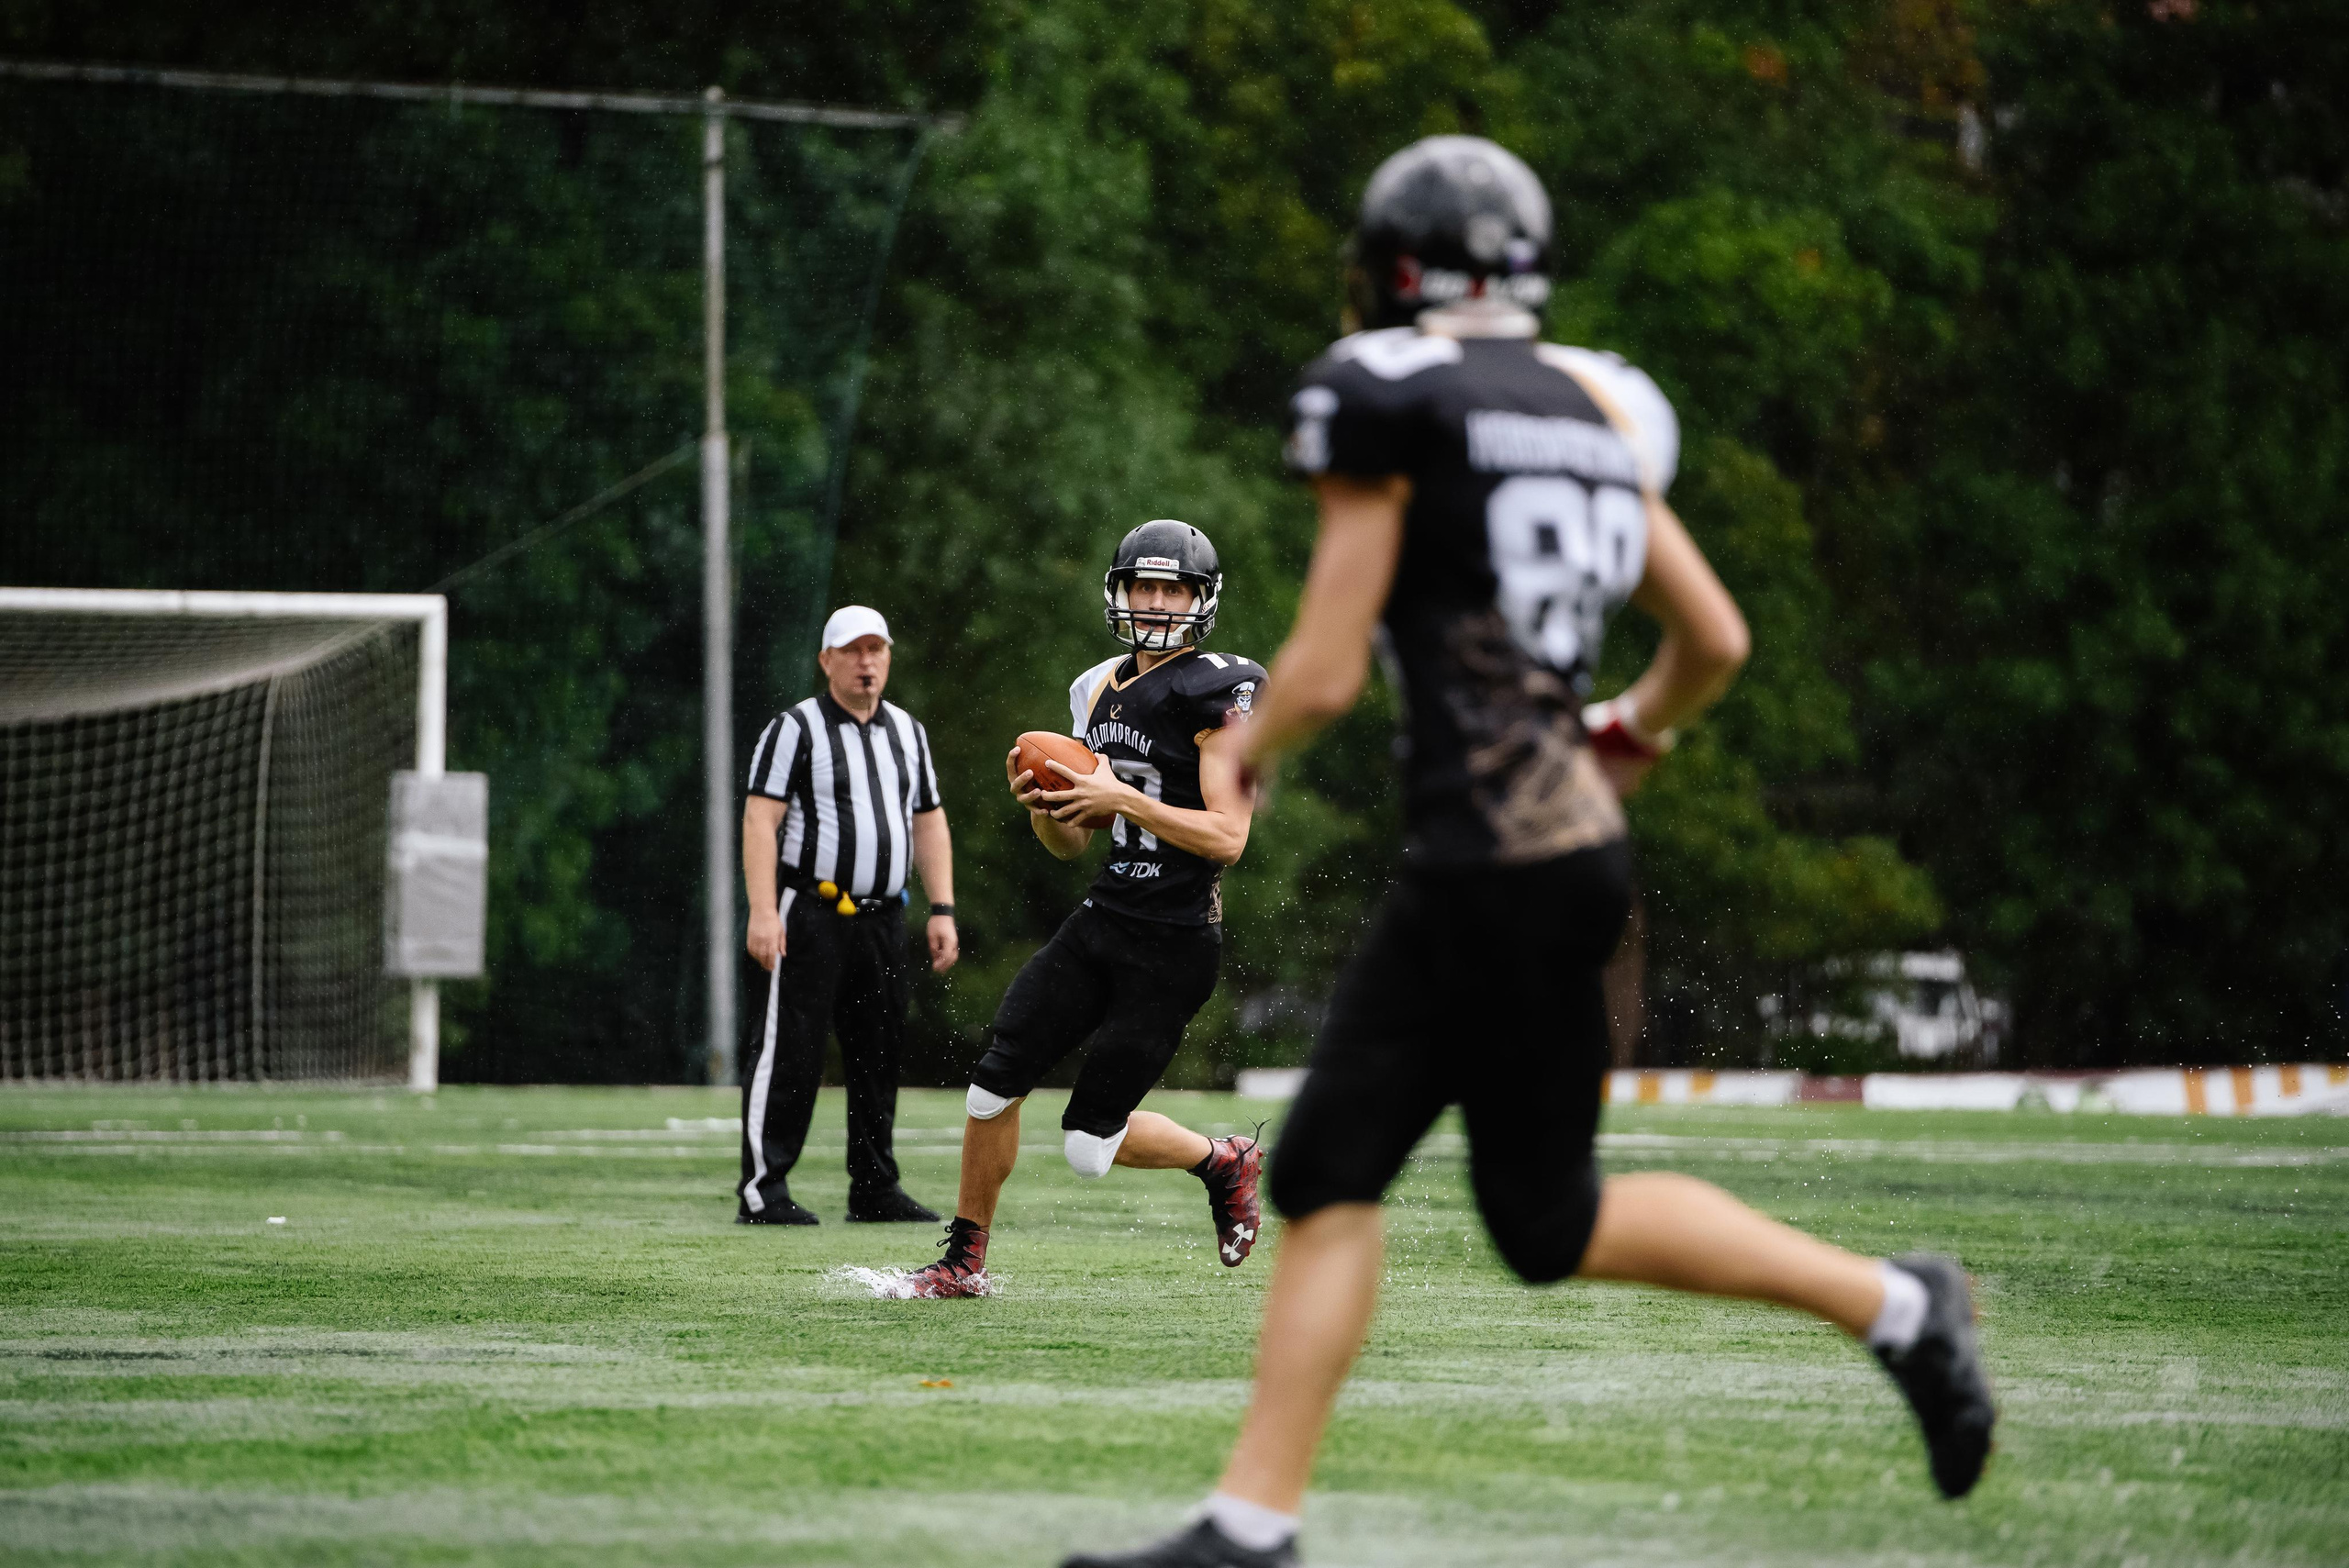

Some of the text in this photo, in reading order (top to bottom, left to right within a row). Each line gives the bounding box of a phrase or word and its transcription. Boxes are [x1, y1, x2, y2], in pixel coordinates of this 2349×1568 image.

[1146, 559, 1170, 567] Riddell
[1085, 721, 1152, 757] АДМИРАЛЫ
[1130, 862, 1163, 878] TDK
